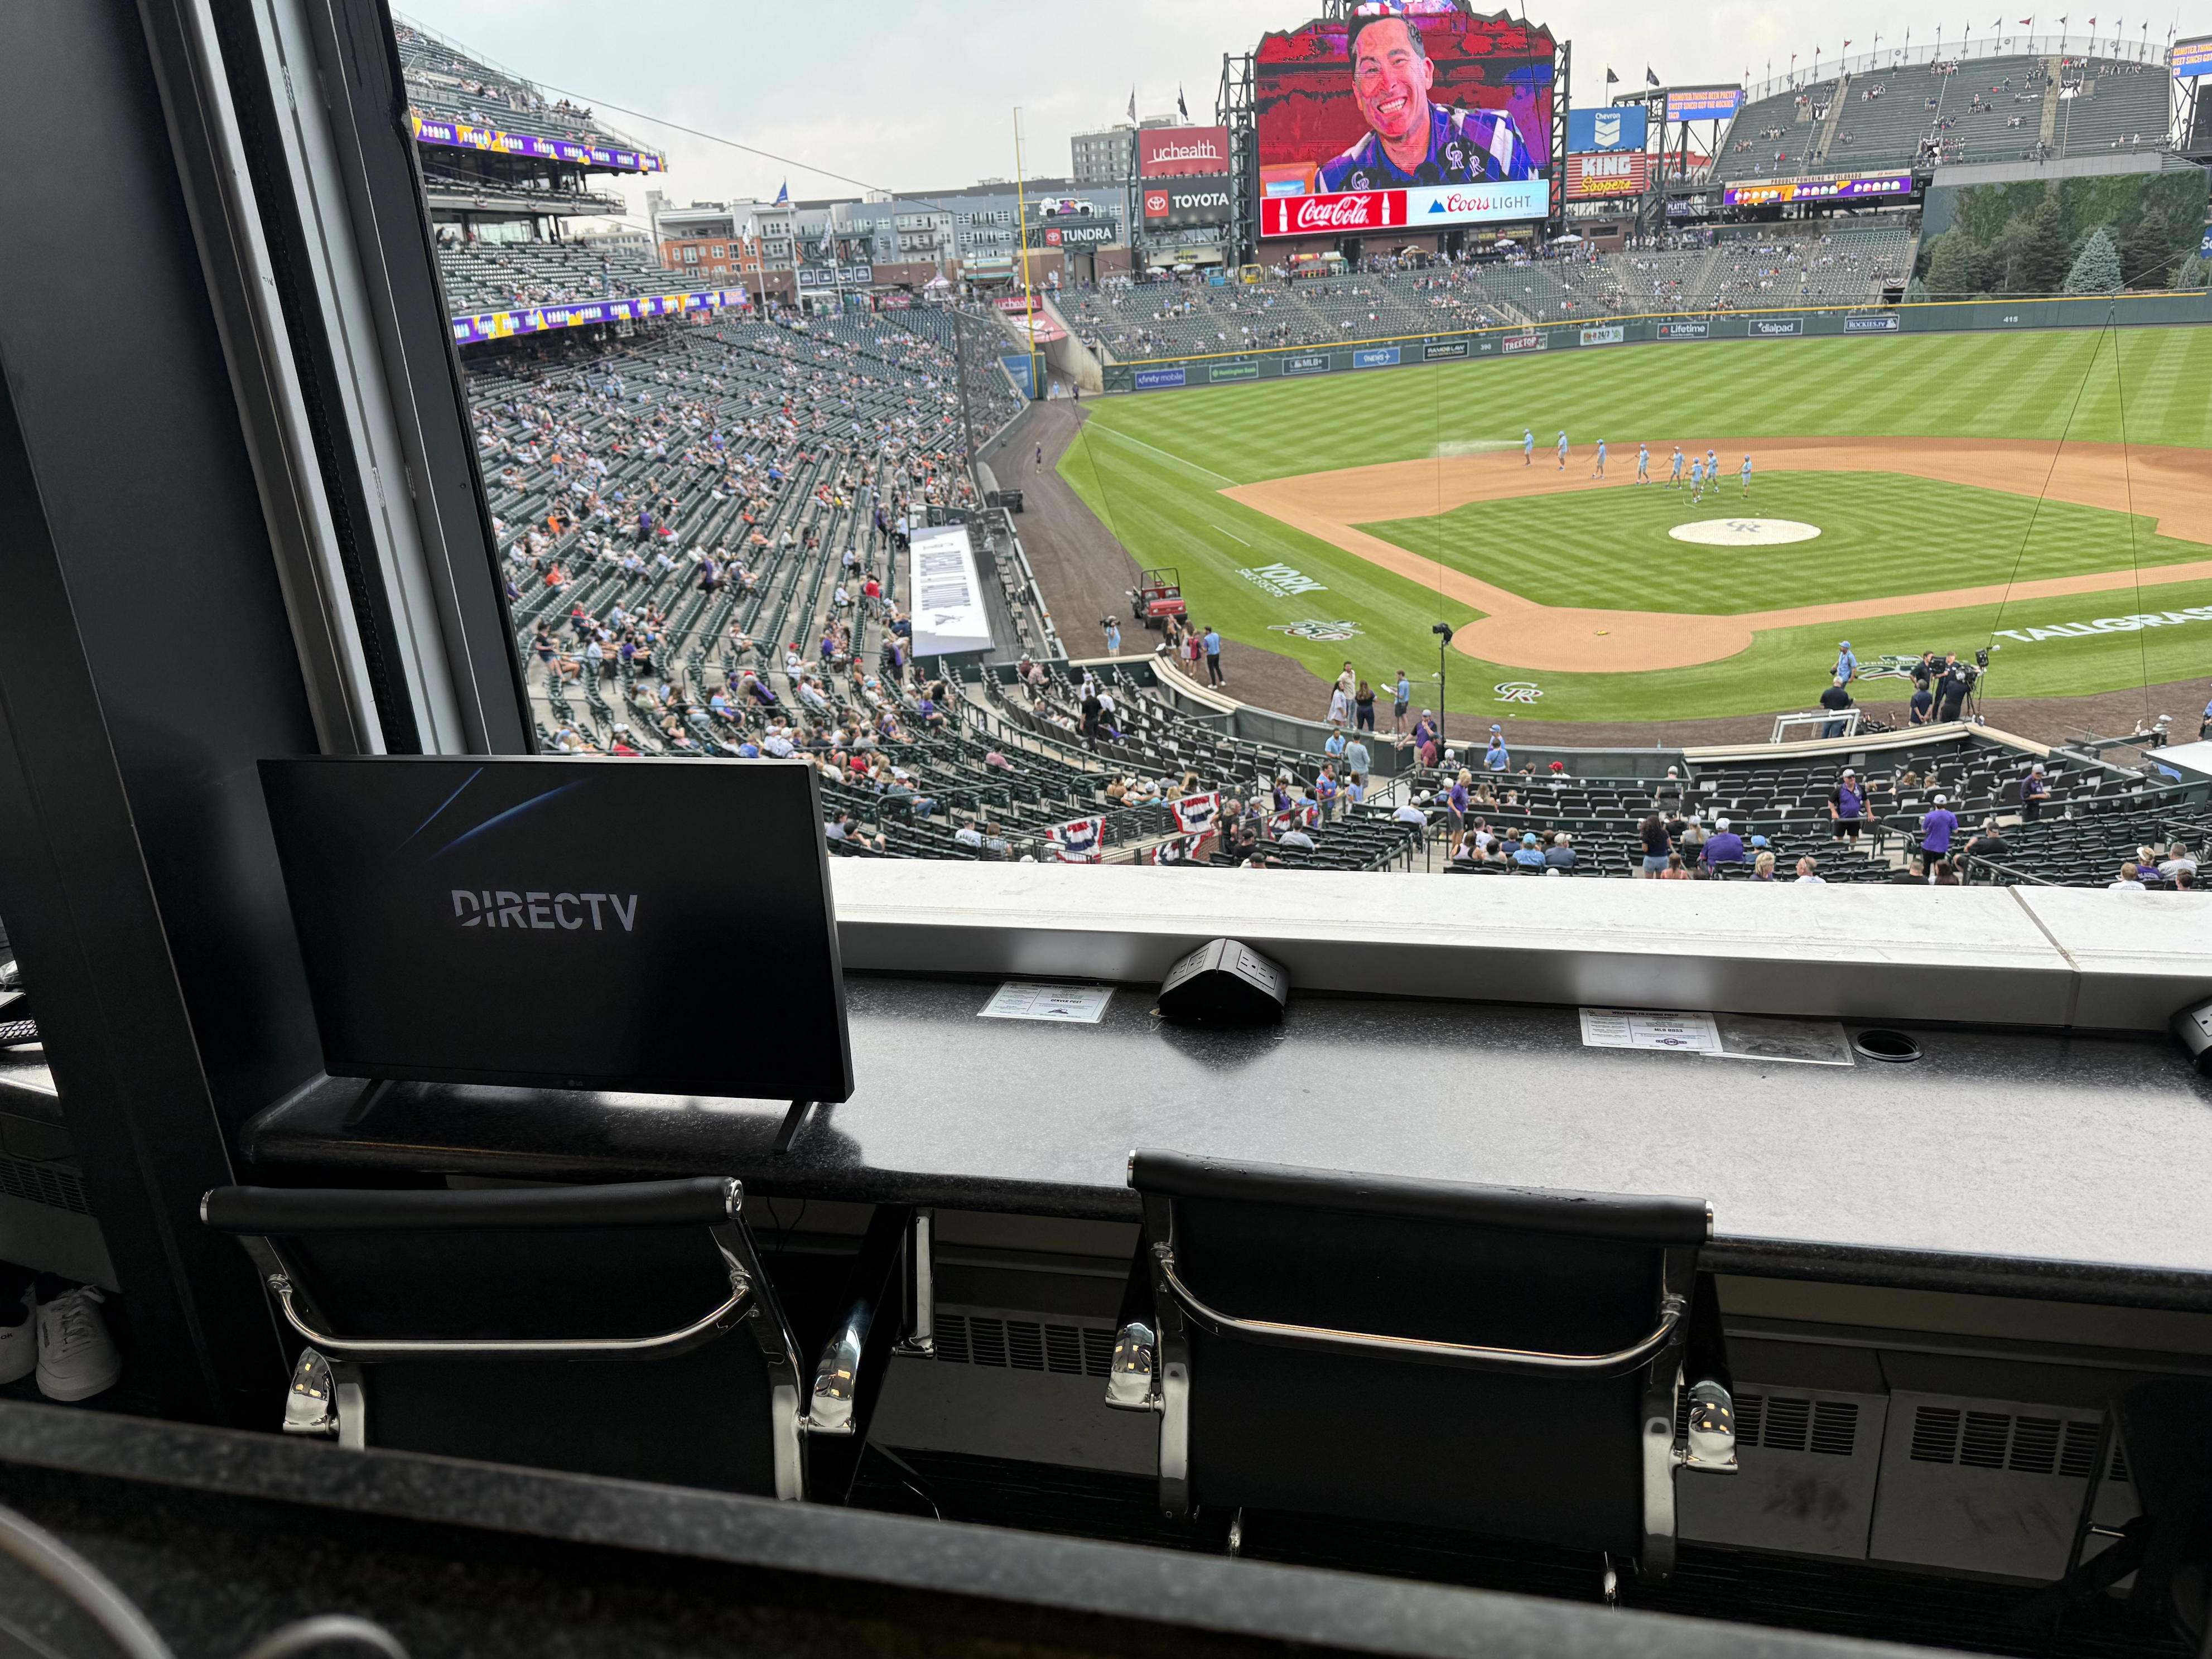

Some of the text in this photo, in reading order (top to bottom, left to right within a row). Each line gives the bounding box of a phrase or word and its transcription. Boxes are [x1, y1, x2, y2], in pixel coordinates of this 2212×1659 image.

[1153, 139, 1217, 162] uchealth
[1582, 156, 1631, 177] KING
[1579, 176, 1632, 196] Soopers
[1172, 192, 1230, 209] TOYOTA
[1447, 193, 1531, 213] Coors LIGHT
[1668, 202, 1686, 211] PLATTE
[1297, 195, 1372, 228] Coca-Cola
[1061, 226, 1112, 242] TUNDRA
[997, 296, 1037, 310] uchealh
[1670, 324, 1706, 334] Lifetime
[1761, 322, 1794, 334] dialpad
[1505, 336, 1536, 351] TREE TOP
[1138, 373, 1183, 385] xfinity mobile
[1252, 562, 1329, 595] YORK
[451, 889, 638, 932] DIRECTV
